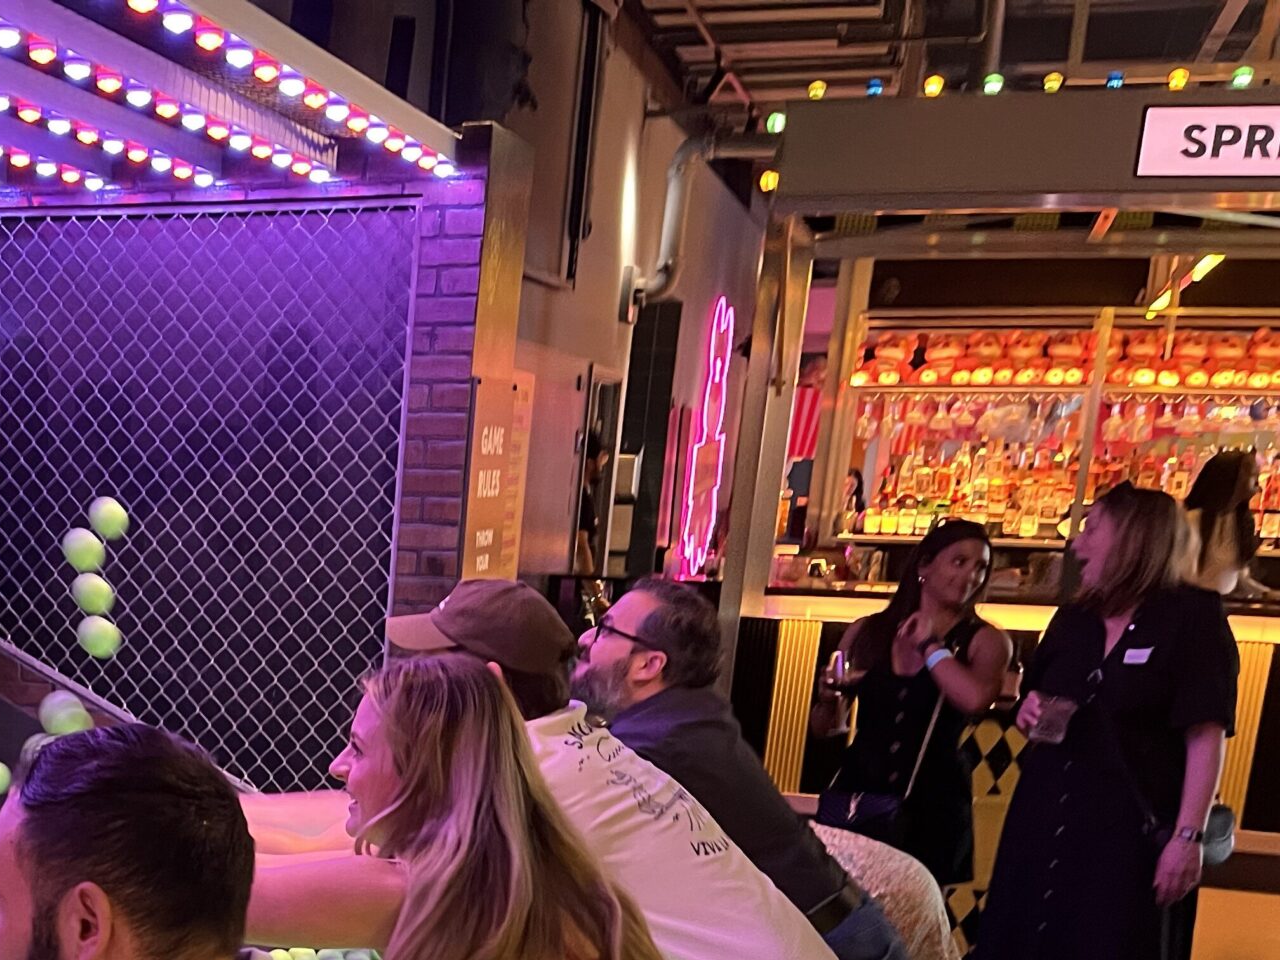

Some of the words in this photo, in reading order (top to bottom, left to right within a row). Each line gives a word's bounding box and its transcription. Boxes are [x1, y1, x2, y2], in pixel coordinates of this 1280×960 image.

[1180, 124, 1280, 159] SPR
[481, 425, 505, 456] GAME
[477, 469, 501, 498] RULES
